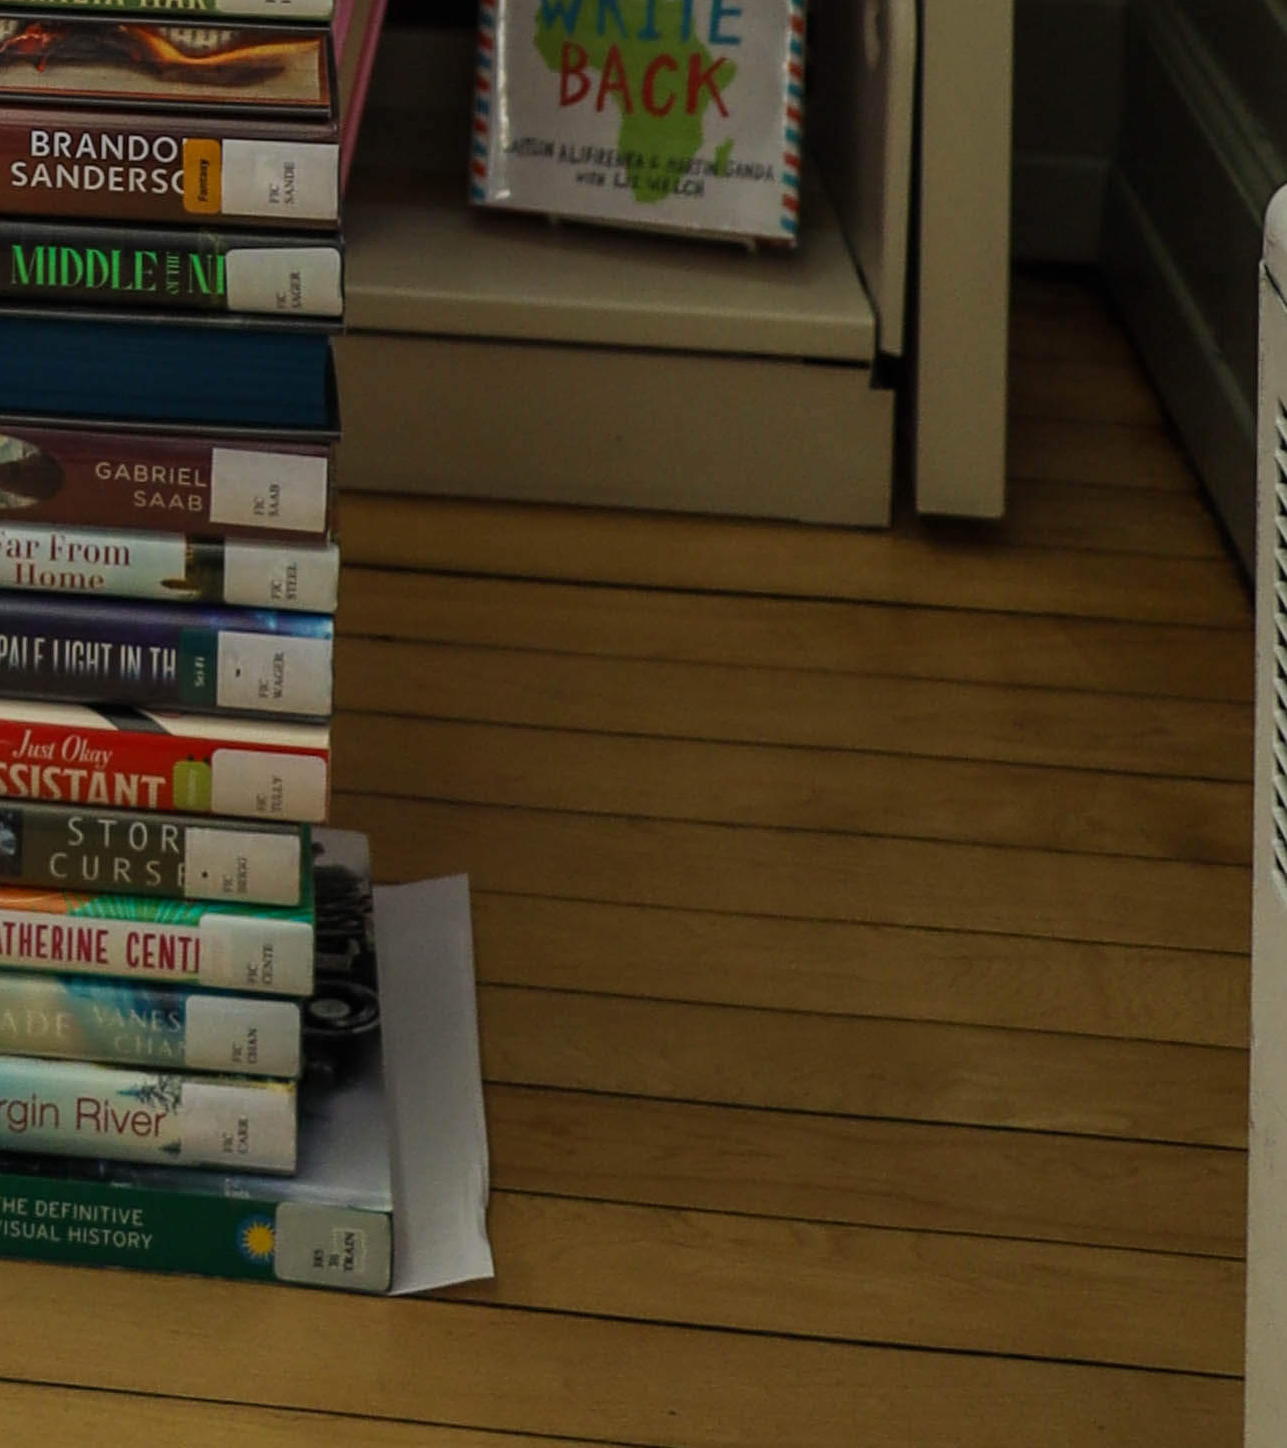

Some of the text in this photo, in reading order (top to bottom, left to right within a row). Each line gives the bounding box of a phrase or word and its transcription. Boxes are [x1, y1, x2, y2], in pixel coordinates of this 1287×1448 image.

[559, 41, 729, 119] BACK
[134, 490, 202, 511] SAAB
[76, 1097, 167, 1138] River
[35, 1200, 143, 1226] DEFINITIVE
[68, 1227, 153, 1249] HISTORY
